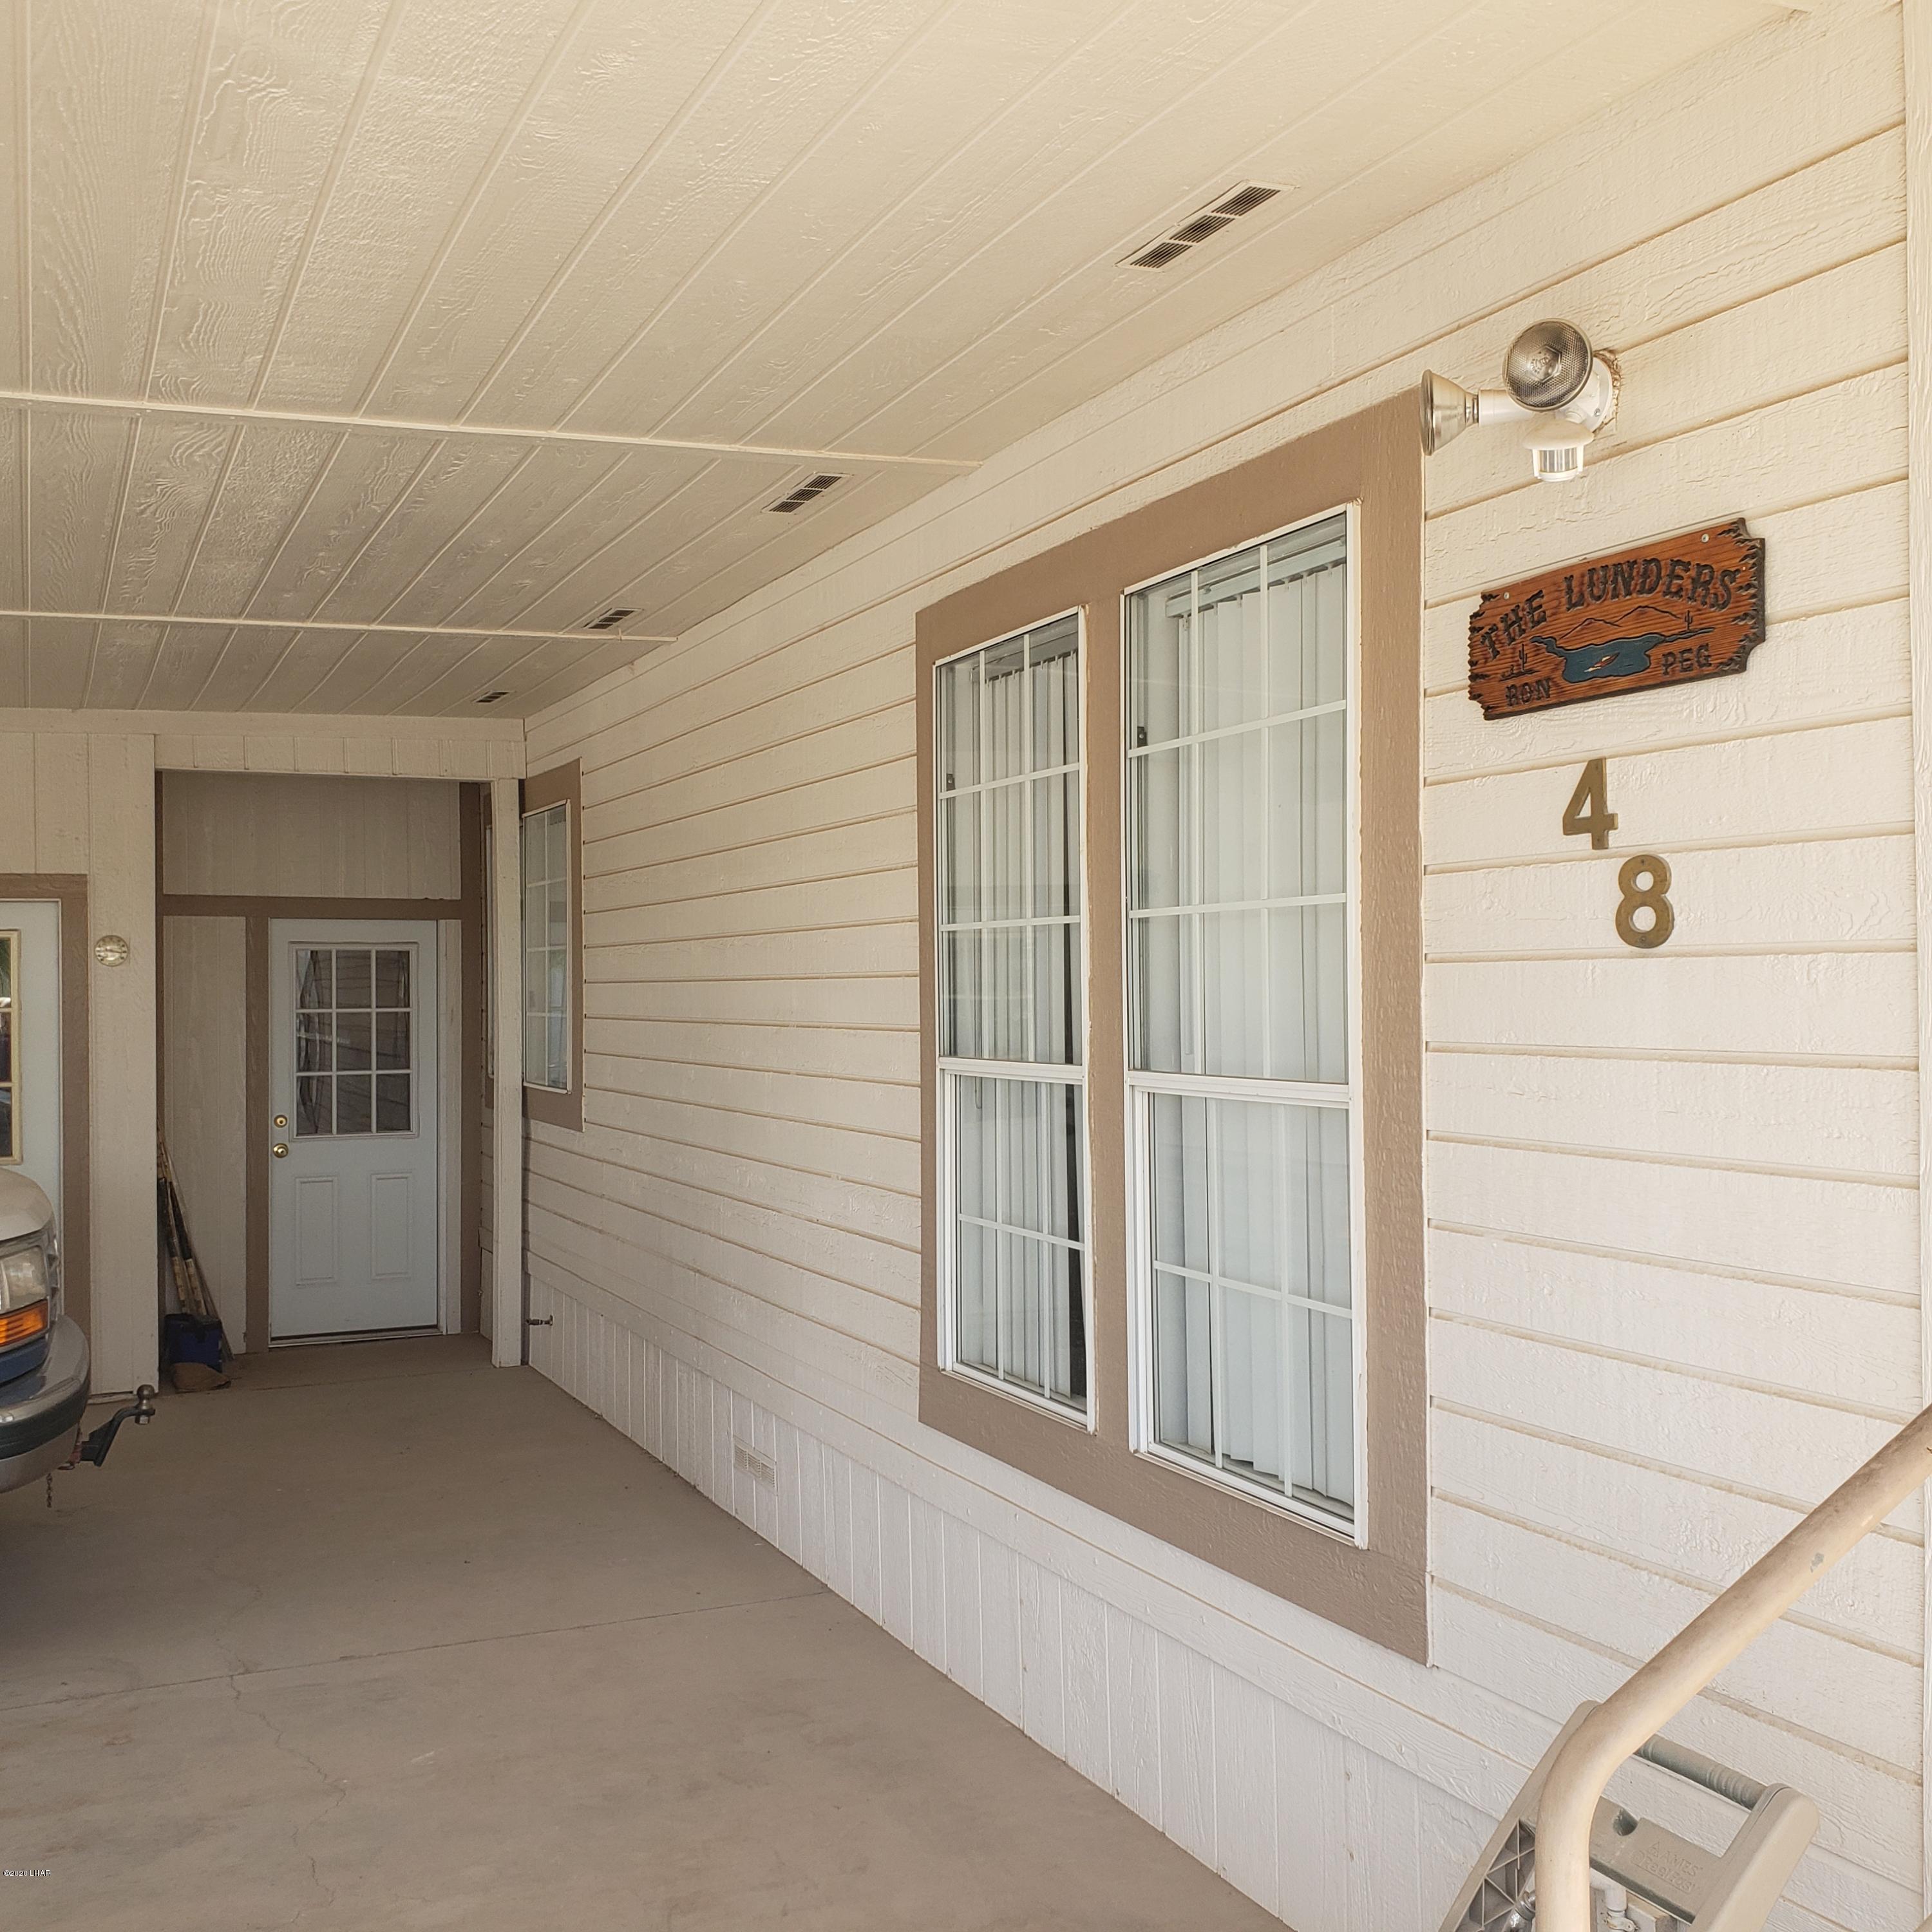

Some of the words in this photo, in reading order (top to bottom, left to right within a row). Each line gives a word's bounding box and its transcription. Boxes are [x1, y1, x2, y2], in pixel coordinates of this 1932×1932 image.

[1481, 590, 1548, 661] THE
[1563, 557, 1740, 612] LUNDERS
[1662, 643, 1712, 676] PEG
[1505, 677, 1551, 708] RON
[1562, 757, 1618, 850] 4
[1615, 854, 1674, 949] 8
[1660, 1850, 1699, 1877] AMES
